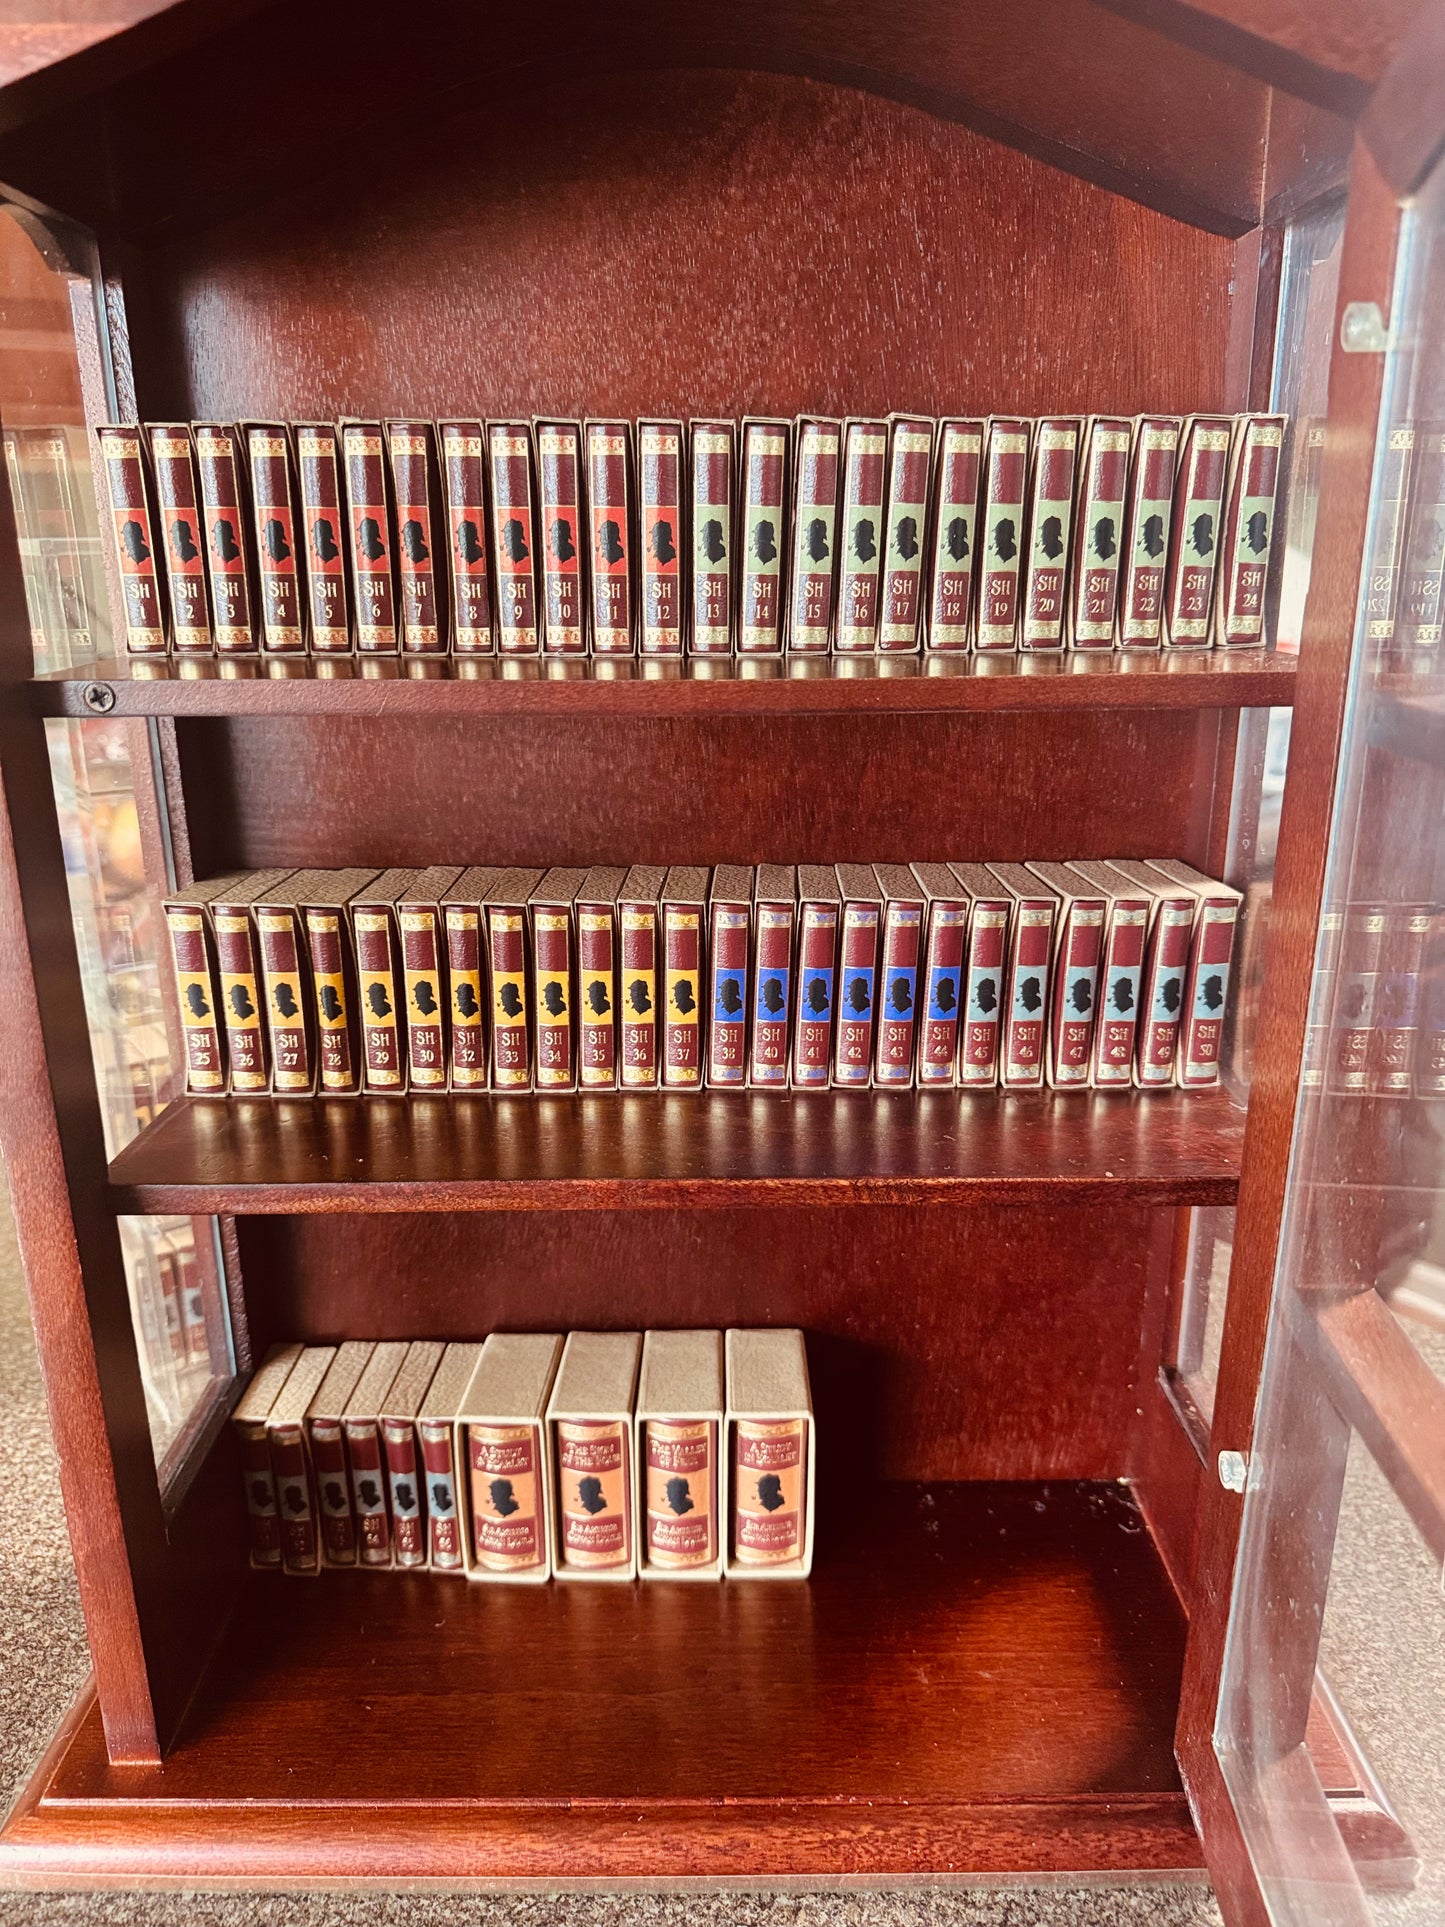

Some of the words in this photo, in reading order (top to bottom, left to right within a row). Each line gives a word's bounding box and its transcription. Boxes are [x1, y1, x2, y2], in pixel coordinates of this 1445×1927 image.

[1038, 576, 1057, 592] SH
[1090, 576, 1109, 592] SH
[1139, 575, 1158, 590] SH
[1187, 574, 1206, 590] SH
[1242, 572, 1261, 587] SH
[130, 583, 150, 598] SH
[177, 583, 198, 598] SH
[219, 582, 239, 597] SH
[268, 582, 289, 597] SH
[317, 583, 337, 598] SH
[364, 581, 384, 596] SH
[406, 581, 426, 596] SH
[461, 583, 481, 598] SH
[507, 583, 527, 598] SH
[552, 582, 572, 597] SH
[600, 583, 620, 598] SH
[652, 583, 671, 598] SH
[702, 582, 721, 597] SH
[752, 582, 771, 598] SH
[804, 581, 823, 597] SH
[851, 581, 870, 597] SH
[893, 579, 912, 595] SH
[944, 580, 962, 596] SH
[991, 580, 1010, 596] SH
[1039, 598, 1054, 612] 20
[1091, 600, 1104, 613] 21
[1140, 598, 1154, 611] 22
[1188, 598, 1202, 610] 23
[1242, 594, 1257, 607] 24
[186, 605, 194, 619] 2
[228, 604, 235, 618] 3
[277, 604, 286, 617] 4
[325, 605, 333, 618] 5
[372, 604, 381, 617] 6
[416, 603, 422, 617] 7
[470, 606, 478, 620] 8
[515, 606, 522, 620] 9
[557, 604, 570, 618] 10
[606, 606, 618, 620] 11
[657, 606, 670, 619] 12
[707, 604, 720, 618] 13
[756, 605, 769, 619] 14
[808, 604, 820, 618] 15
[854, 604, 868, 618] 16
[896, 602, 909, 616] 17
[946, 603, 960, 616] 18
[994, 603, 1008, 616] 19
[416, 1032, 434, 1045] SH
[458, 1032, 475, 1045] SH
[544, 1032, 562, 1045] SH
[589, 1031, 606, 1044] SH
[630, 1030, 648, 1043] SH
[674, 1030, 691, 1043] SH
[720, 1028, 737, 1042] SH
[762, 1028, 780, 1041] SH
[806, 1028, 823, 1041] SH
[846, 1028, 864, 1041] SH
[888, 1028, 906, 1041] SH
[932, 1027, 950, 1040] SH
[973, 1028, 990, 1042] SH
[1018, 1028, 1036, 1040] SH
[1068, 1028, 1086, 1042] SH
[1109, 1028, 1128, 1040] SH
[1156, 1028, 1174, 1041] SH
[1198, 1026, 1216, 1038] SH
[190, 1034, 210, 1048] SH
[234, 1035, 252, 1048] SH
[278, 1035, 298, 1048] SH
[324, 1035, 340, 1048] SH
[371, 1033, 390, 1046] SH
[502, 1032, 520, 1046] SH
[420, 1050, 434, 1062] 30
[461, 1050, 475, 1062] 32
[506, 1051, 518, 1062] 33
[548, 1050, 561, 1062] 34
[592, 1049, 604, 1062] 35
[633, 1048, 646, 1060] 36
[677, 1048, 690, 1060] 37
[722, 1048, 735, 1059] 38
[764, 1046, 778, 1058] 40
[808, 1046, 820, 1058] 41
[848, 1047, 861, 1058] 42
[890, 1047, 903, 1058] 43
[934, 1046, 948, 1056] 44
[975, 1047, 988, 1058] 45
[1158, 1047, 1170, 1058] 49
[196, 1053, 210, 1065] 25
[239, 1054, 254, 1066] 26
[283, 1053, 298, 1065] 27
[328, 1054, 341, 1066] 28
[376, 1052, 389, 1064] 29
